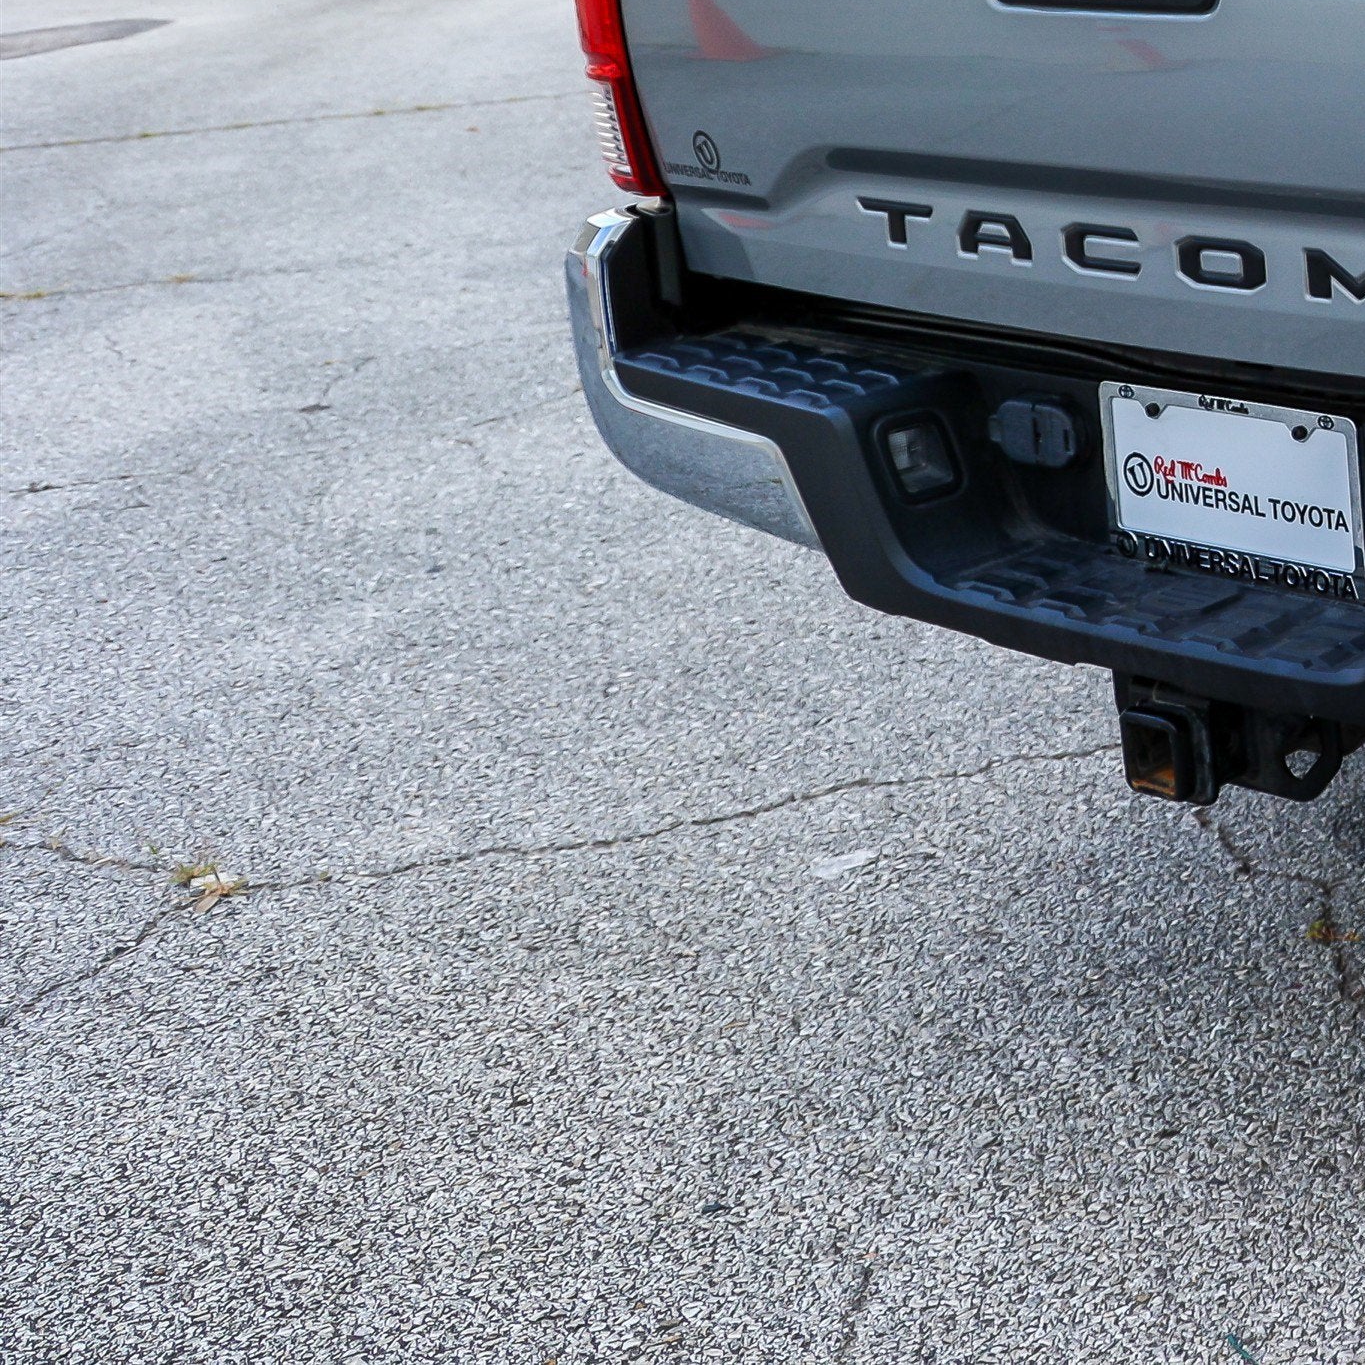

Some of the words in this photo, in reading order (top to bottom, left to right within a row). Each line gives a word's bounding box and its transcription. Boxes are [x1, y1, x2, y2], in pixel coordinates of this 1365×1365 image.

[662, 161, 714, 181] UNIVERSAL
[716, 170, 753, 187] TOYOTA
[1153, 455, 1176, 484] Red
[1156, 477, 1267, 518] UNIVERSAL
[1267, 497, 1350, 533] TOYOTA
[1144, 535, 1269, 581] UNIVERSAL
[1269, 559, 1360, 601] TOYOTA
